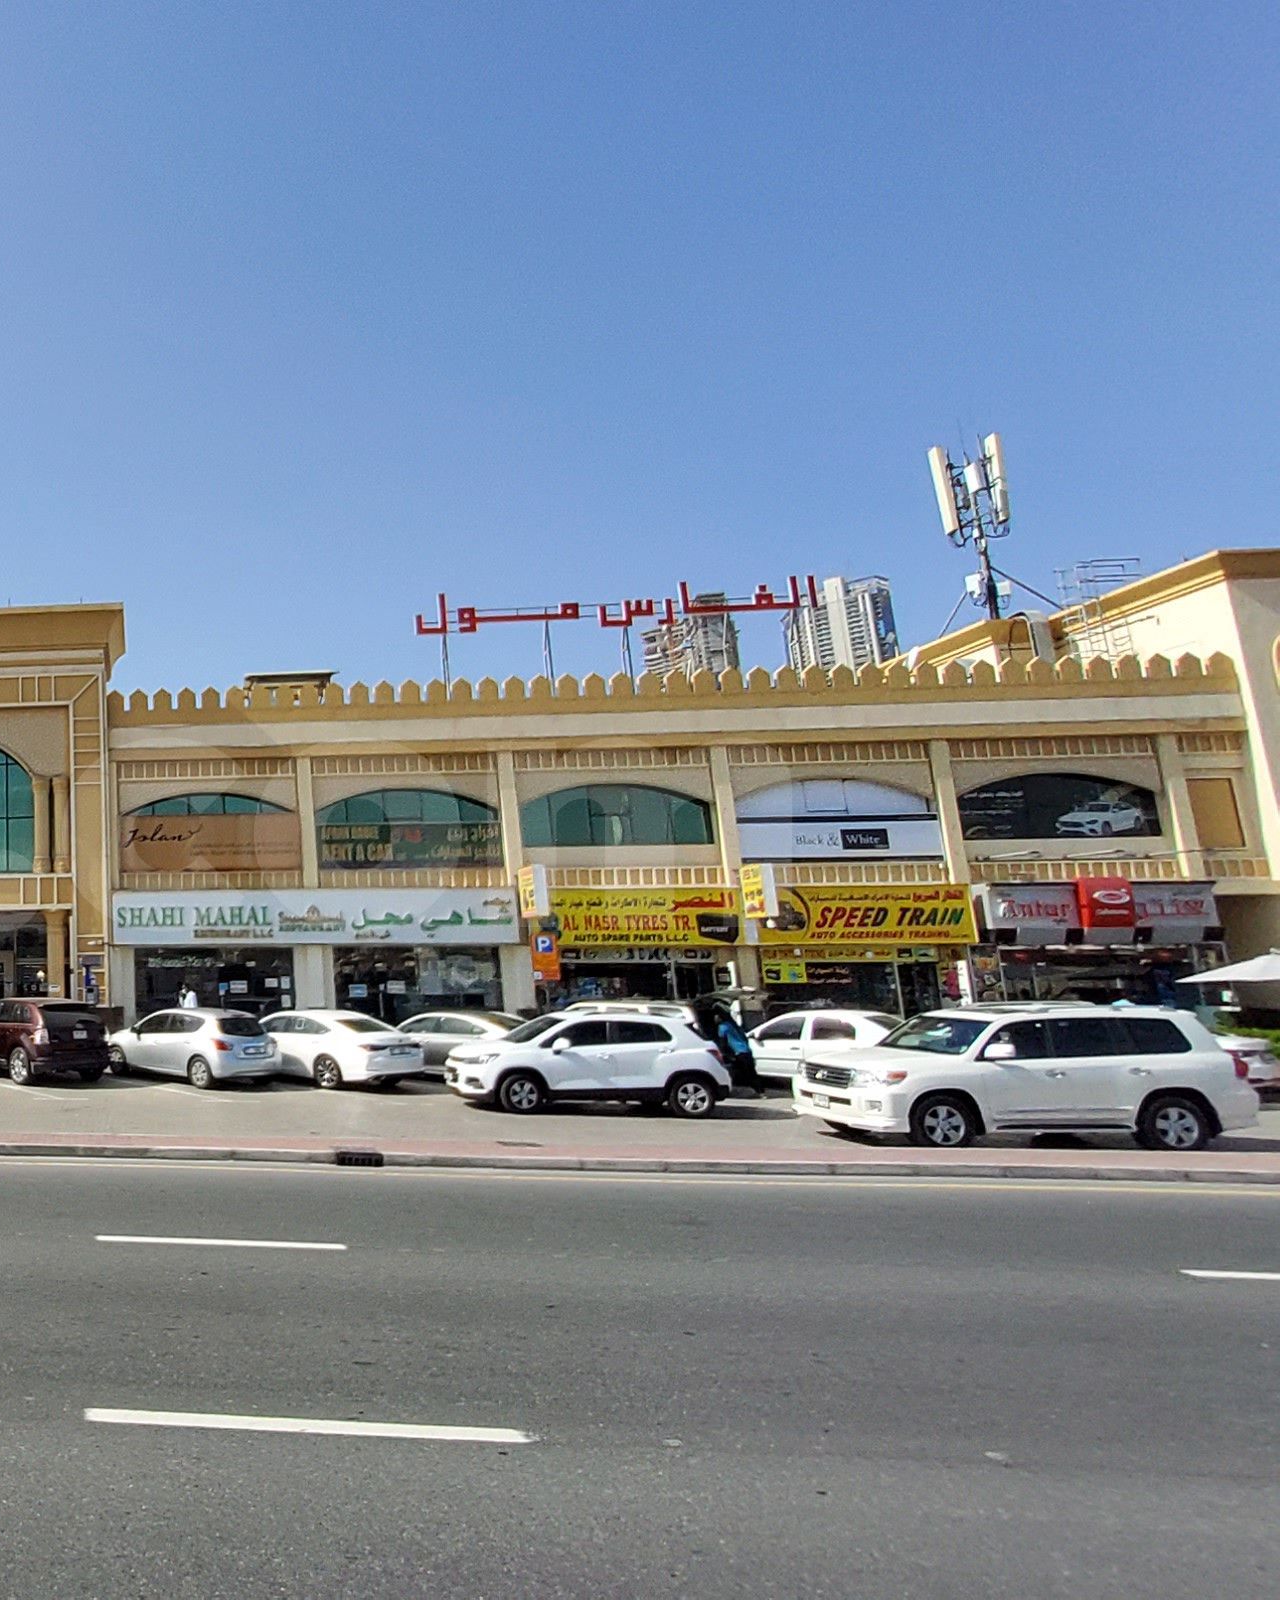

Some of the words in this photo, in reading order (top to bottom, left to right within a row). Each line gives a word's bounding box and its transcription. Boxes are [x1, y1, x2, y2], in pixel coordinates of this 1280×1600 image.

[597, 575, 818, 628] الفارس
[415, 592, 580, 635] مول
[845, 833, 881, 845] White
[666, 891, 734, 913] النصر
[117, 906, 185, 928] SHAHI
[194, 905, 273, 927] MAHAL
[351, 908, 414, 930] محل
[563, 914, 579, 931] AL
[584, 914, 619, 931] NASR
[624, 914, 668, 931] TYRES
[672, 914, 696, 931] TR.
[815, 906, 889, 928] SPEED
[896, 906, 965, 927] TRAIN
[537, 936, 551, 953] P
[573, 933, 598, 942] AUTO
[601, 933, 631, 942] SPARE
[633, 933, 663, 942] PARTS
[810, 931, 835, 939] AUTO
[839, 930, 905, 939] ACCESSORIES
